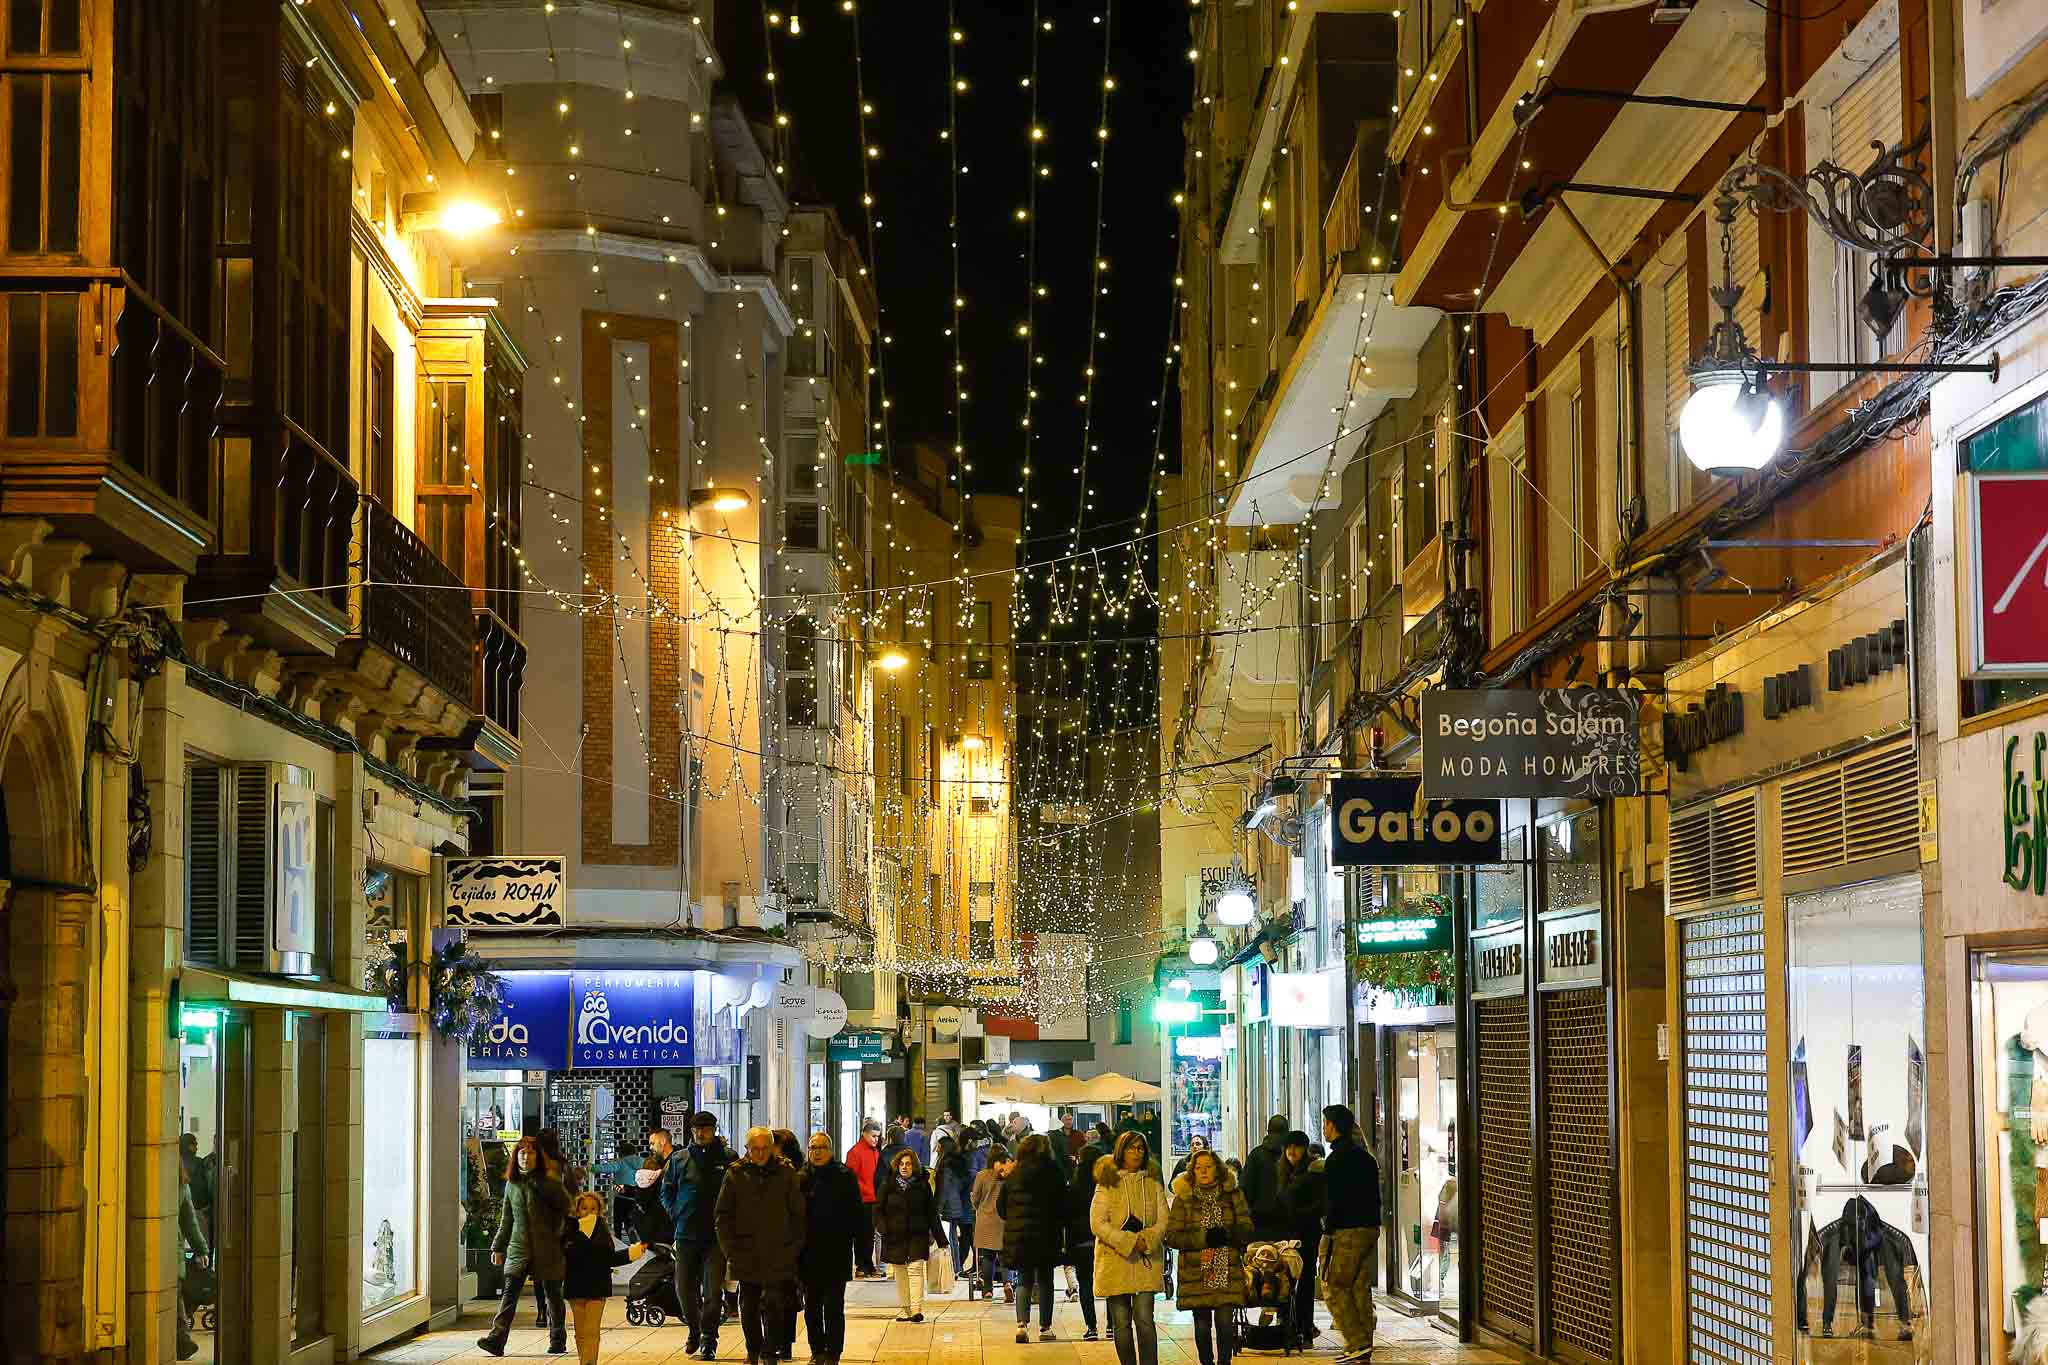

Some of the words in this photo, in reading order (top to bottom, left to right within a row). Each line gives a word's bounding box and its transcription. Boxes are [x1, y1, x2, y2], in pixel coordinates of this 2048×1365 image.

[1439, 711, 1537, 742] Begoña
[1546, 704, 1625, 736] Salam
[1441, 756, 1508, 777] MODA
[1524, 754, 1626, 776] HOMBRE
[449, 883, 497, 907] Tejidos
[502, 882, 558, 901] ROAN
[1479, 944, 1518, 979] MALETAS
[1548, 930, 1590, 968] BOLSOS
[584, 1047, 680, 1060] COSMÉTICA
